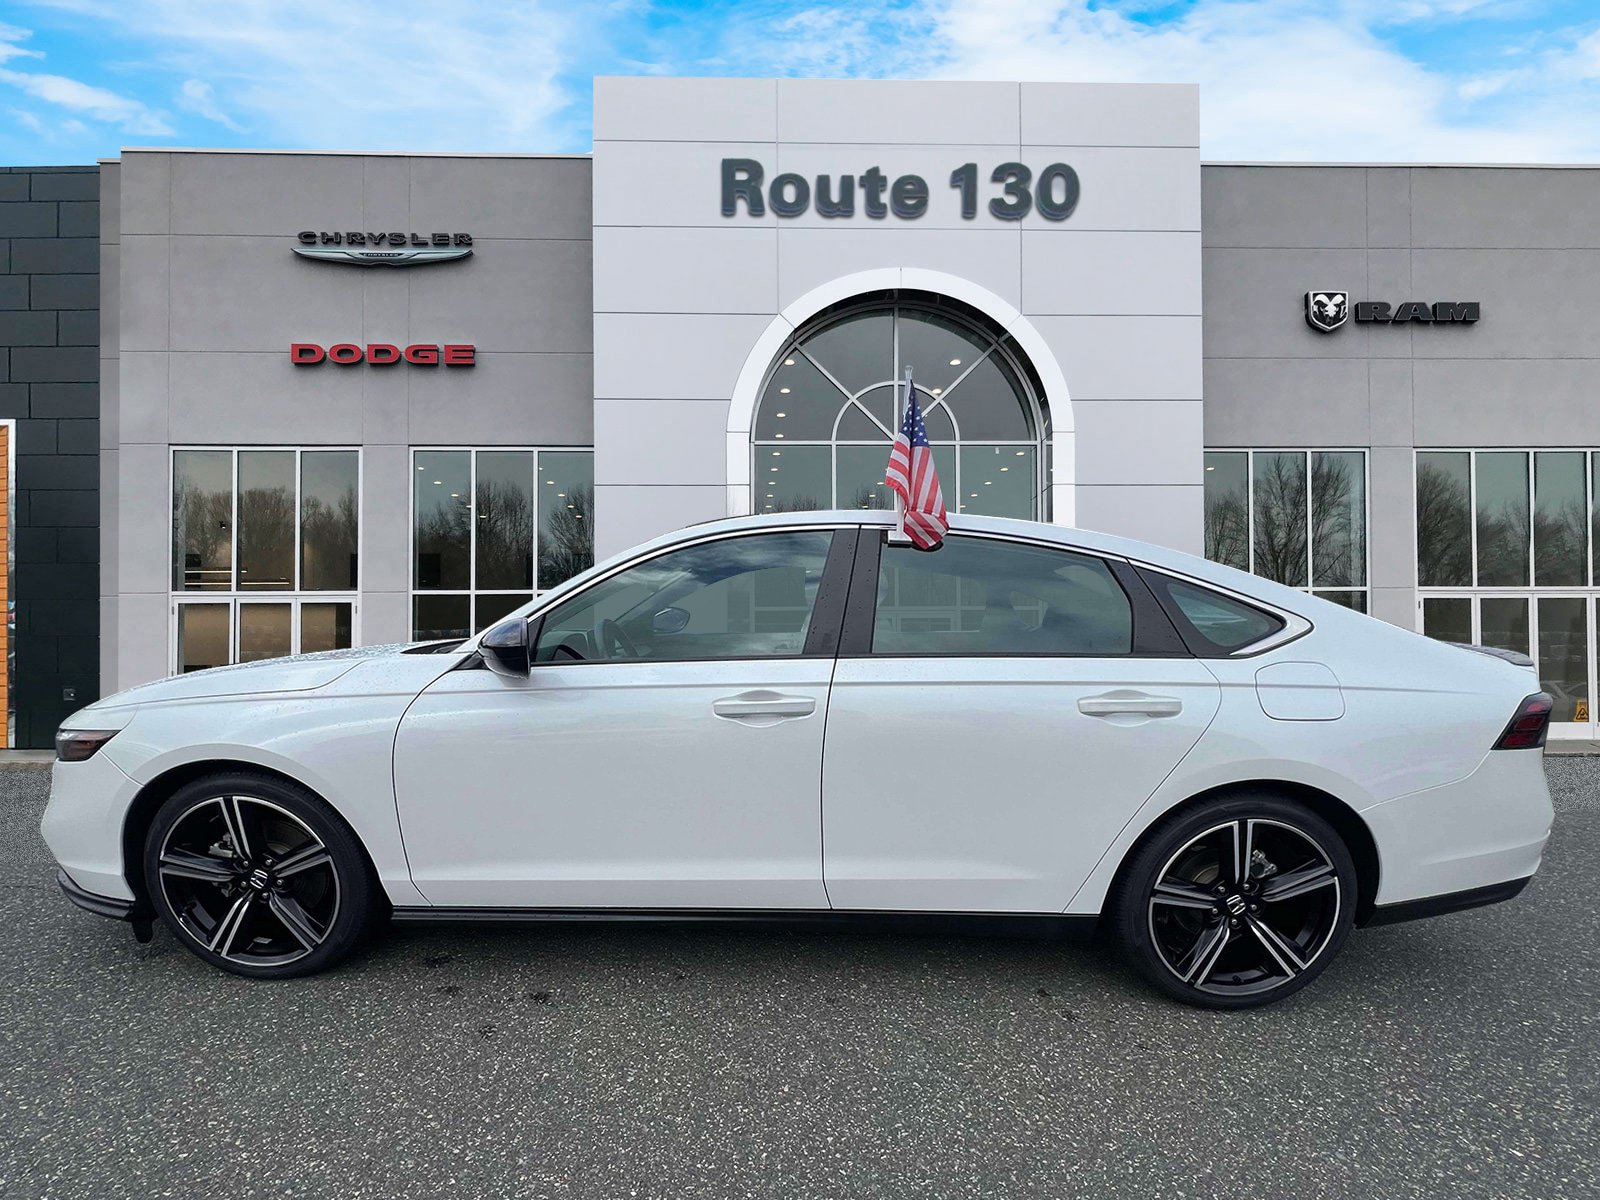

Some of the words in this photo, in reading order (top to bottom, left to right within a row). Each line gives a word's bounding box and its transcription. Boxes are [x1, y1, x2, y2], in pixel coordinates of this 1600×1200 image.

[721, 158, 929, 219] Route
[950, 162, 1081, 221] 130
[298, 231, 474, 245] CHRYSLER
[1354, 301, 1481, 324] RAM
[291, 343, 475, 366] DODGE
